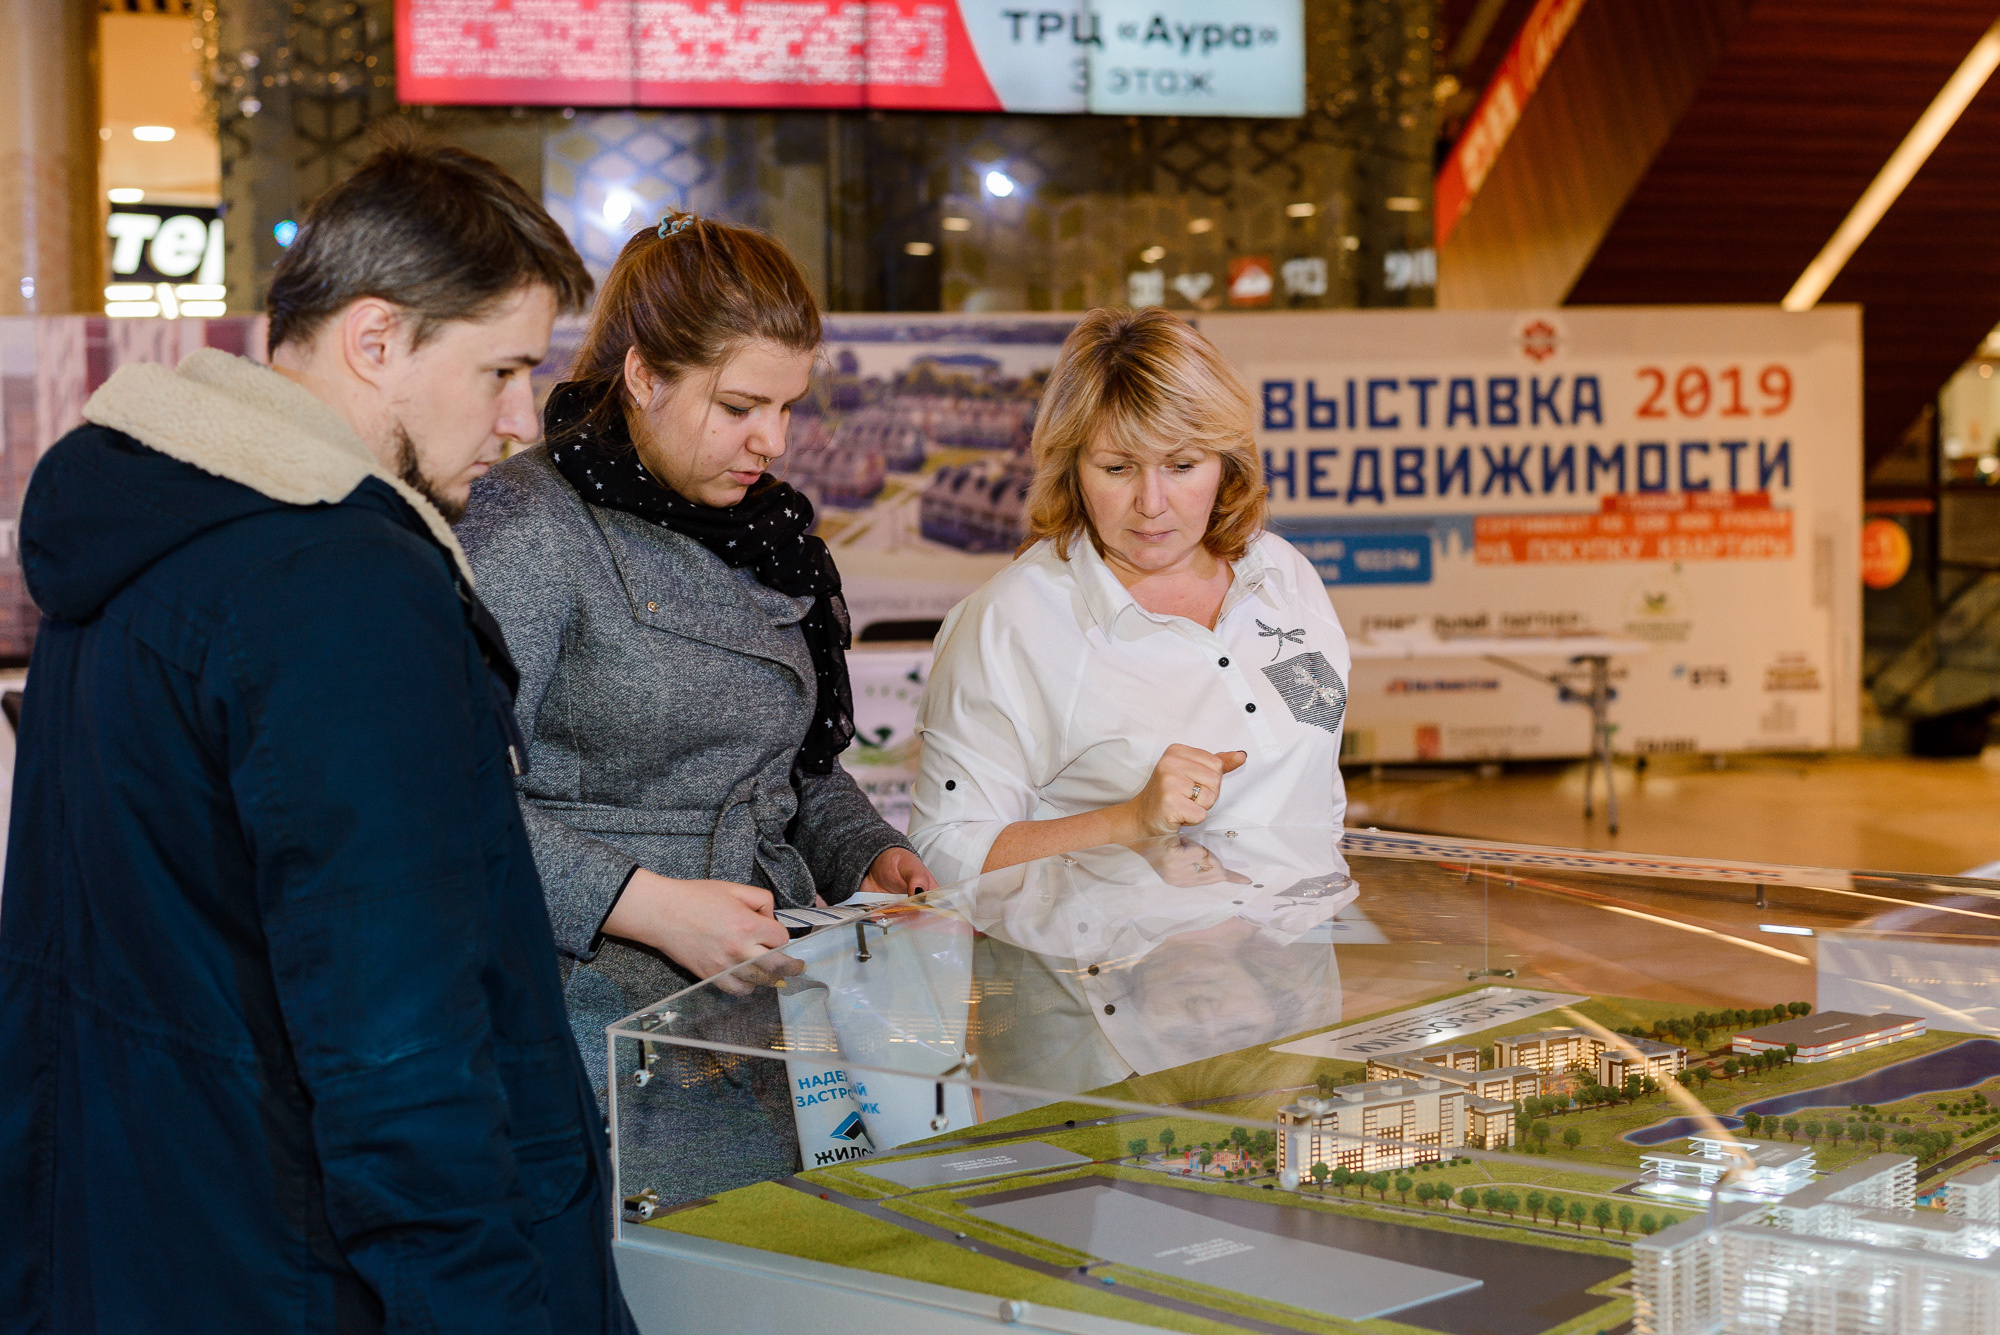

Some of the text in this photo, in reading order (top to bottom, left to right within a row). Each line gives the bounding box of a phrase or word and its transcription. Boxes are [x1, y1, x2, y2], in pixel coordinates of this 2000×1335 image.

[1002, 10, 1278, 56] ТРЦ «Аура»
[1071, 57, 1090, 95] 3
[1261, 364, 1795, 431] ВЫСТАВКА 2019
[1262, 438, 1793, 505] НЕДВИЖИМОСТИ
